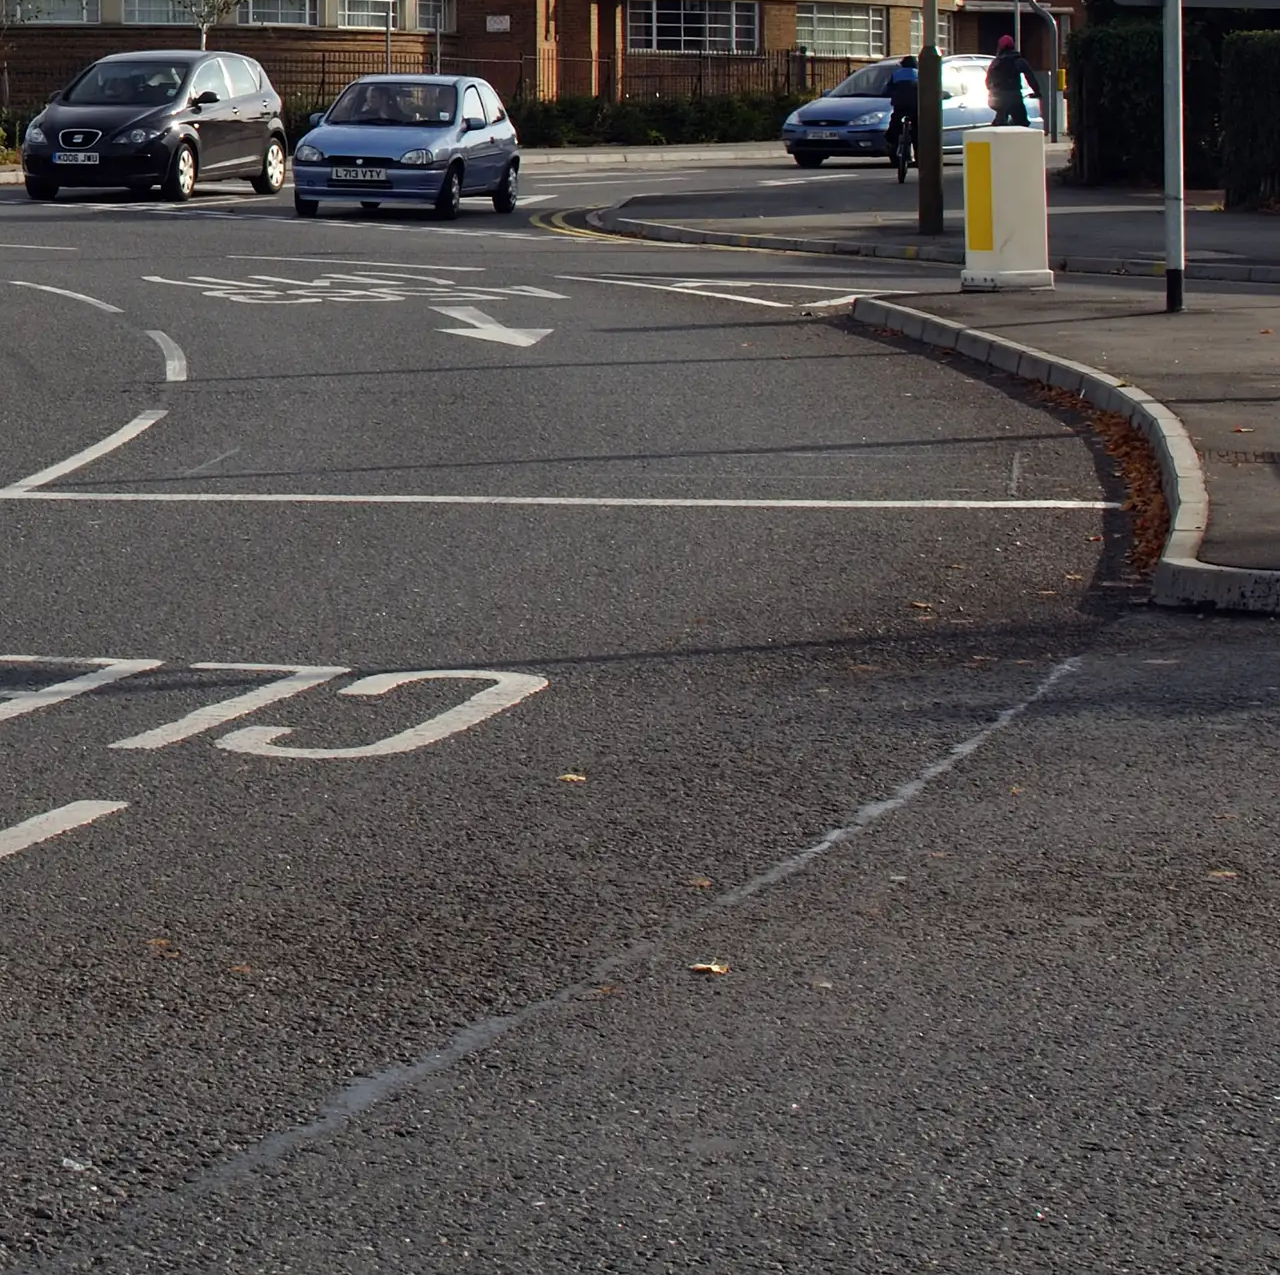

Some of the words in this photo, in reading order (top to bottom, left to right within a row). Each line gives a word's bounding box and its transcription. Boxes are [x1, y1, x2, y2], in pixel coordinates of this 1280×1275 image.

[335, 168, 358, 179] L713
[360, 168, 383, 180] VTY
[201, 285, 571, 304] A563
